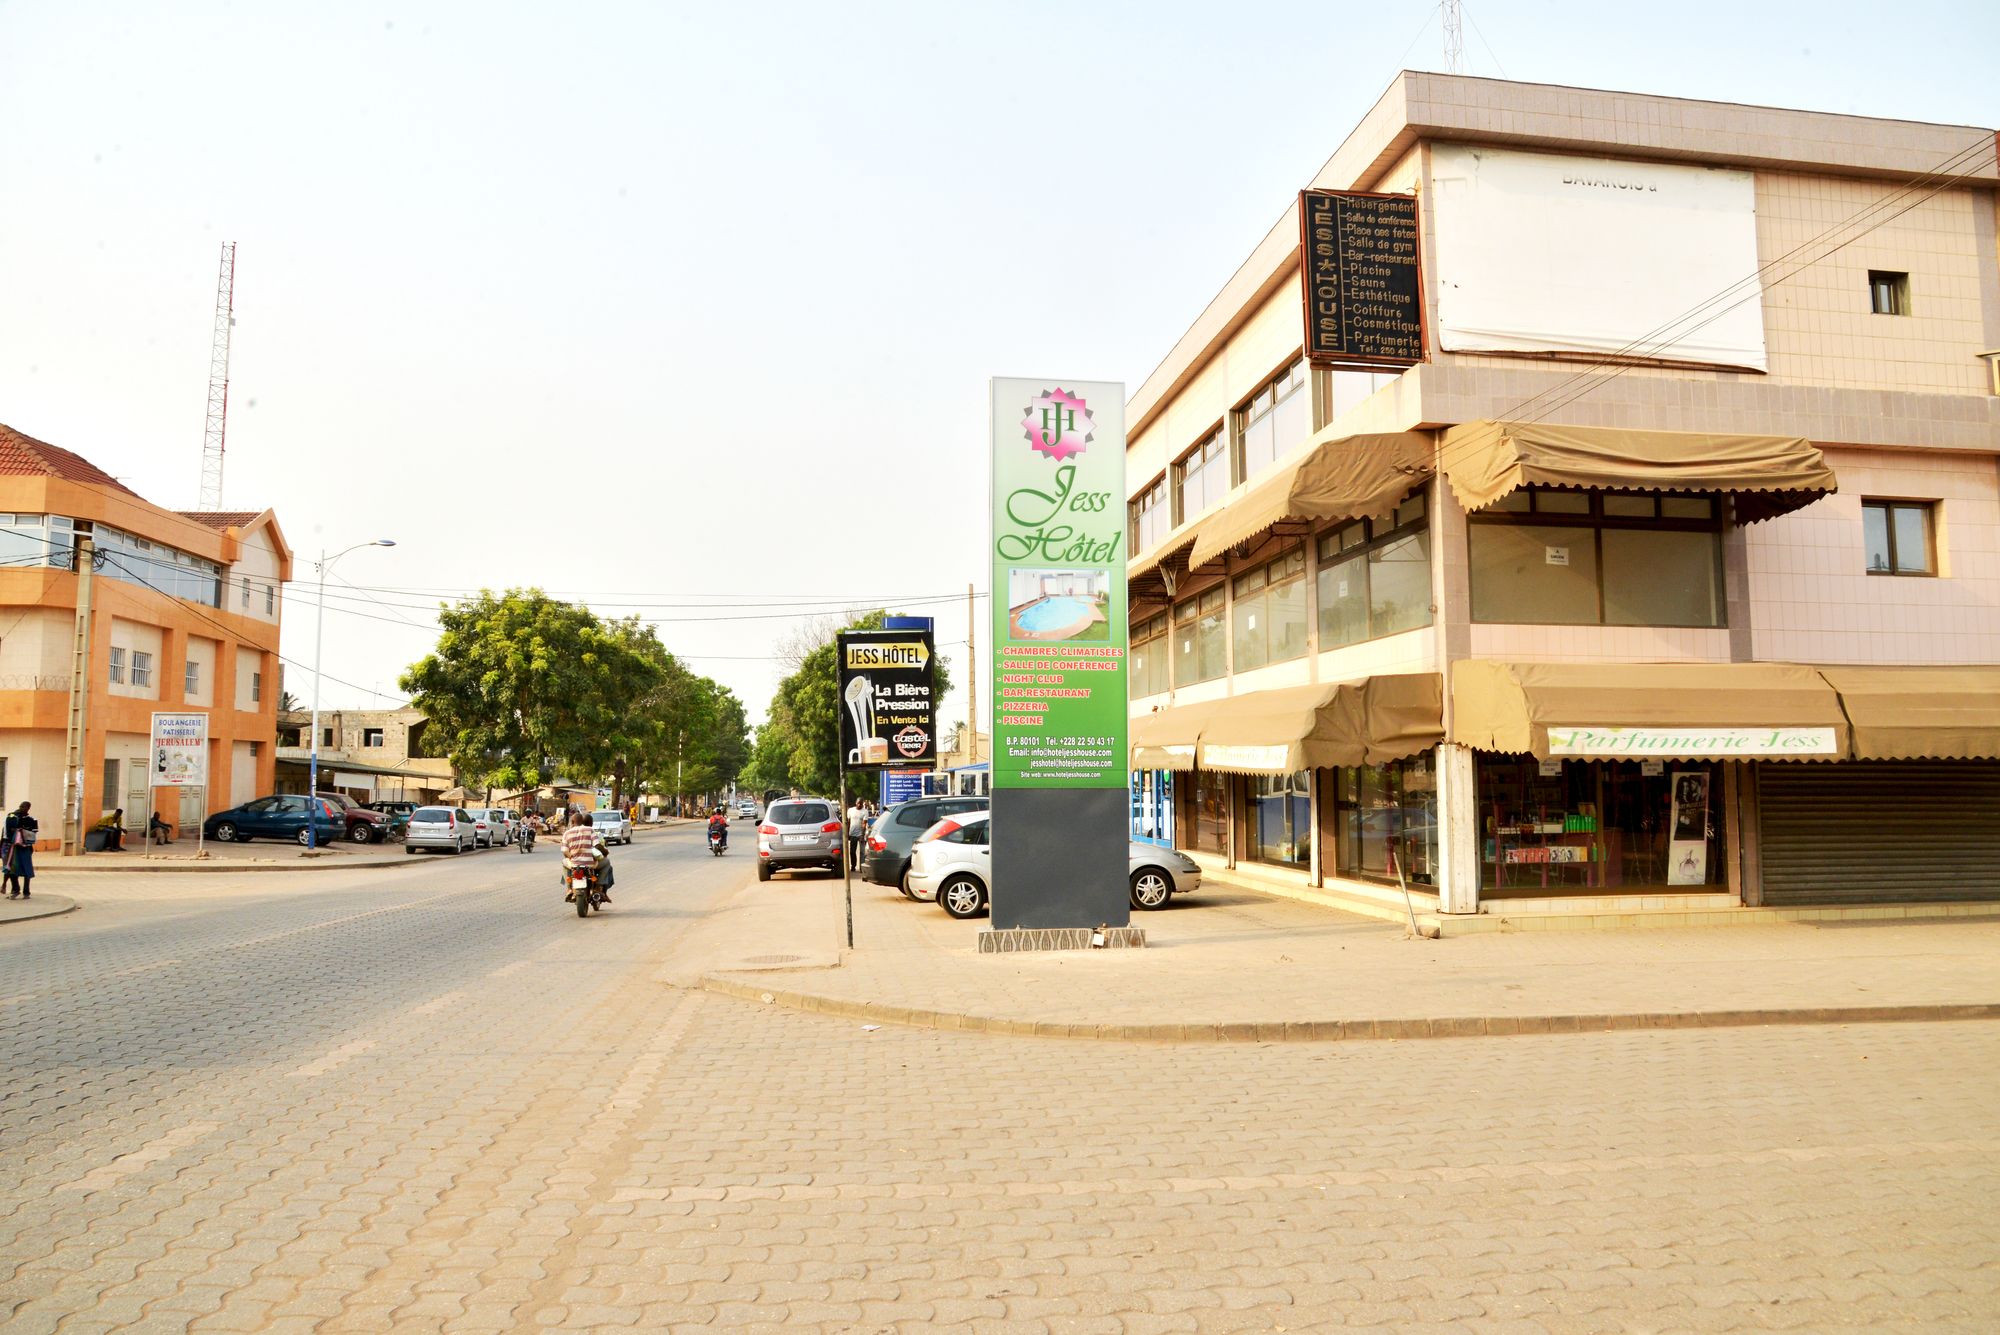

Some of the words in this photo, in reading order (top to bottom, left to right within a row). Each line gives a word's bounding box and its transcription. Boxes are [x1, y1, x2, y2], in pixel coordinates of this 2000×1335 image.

[1346, 212, 1365, 223] Salle
[1367, 213, 1376, 224] de
[1347, 223, 1371, 235] Place
[1348, 236, 1374, 248] Salle
[1377, 240, 1390, 249] de
[1393, 242, 1413, 253] gym
[1350, 262, 1391, 276] Piscine
[1351, 275, 1386, 288] Sauna
[1351, 287, 1411, 305] Esthétique
[1352, 303, 1402, 318] Coiffure
[1353, 316, 1421, 334] Cosmétique
[1354, 331, 1420, 347] Parfumerie
[1380, 346, 1395, 355] 250
[1006, 464, 1111, 528] Jess
[996, 525, 1122, 563] Hôtel
[849, 648, 879, 665] JESS
[883, 645, 922, 664] HÔTEL
[1003, 647, 1058, 655] CHAMBRES
[1003, 661, 1034, 669] SALLE
[1003, 675, 1034, 683] NIGHT
[1037, 675, 1064, 683] CLUB
[875, 684, 891, 697] La
[895, 683, 929, 696] Bière
[875, 698, 930, 711] Pression
[1003, 703, 1048, 711] PIZZERIA
[876, 716, 888, 725] En
[890, 715, 917, 725] Vente
[919, 714, 929, 724] Ici
[1003, 716, 1043, 725] PISCINE
[163, 728, 196, 736] PATISSERIE
[1060, 737, 1076, 746] +228
[1077, 737, 1086, 746] 22
[1087, 737, 1095, 746] 50
[1096, 737, 1105, 746] 43
[1106, 737, 1115, 746] 17
[1565, 730, 1750, 751] Parfumerie
[1760, 730, 1821, 748] Jess
[1009, 748, 1029, 757] Email:
[1031, 747, 1113, 758] info@hoteljesshouse.com
